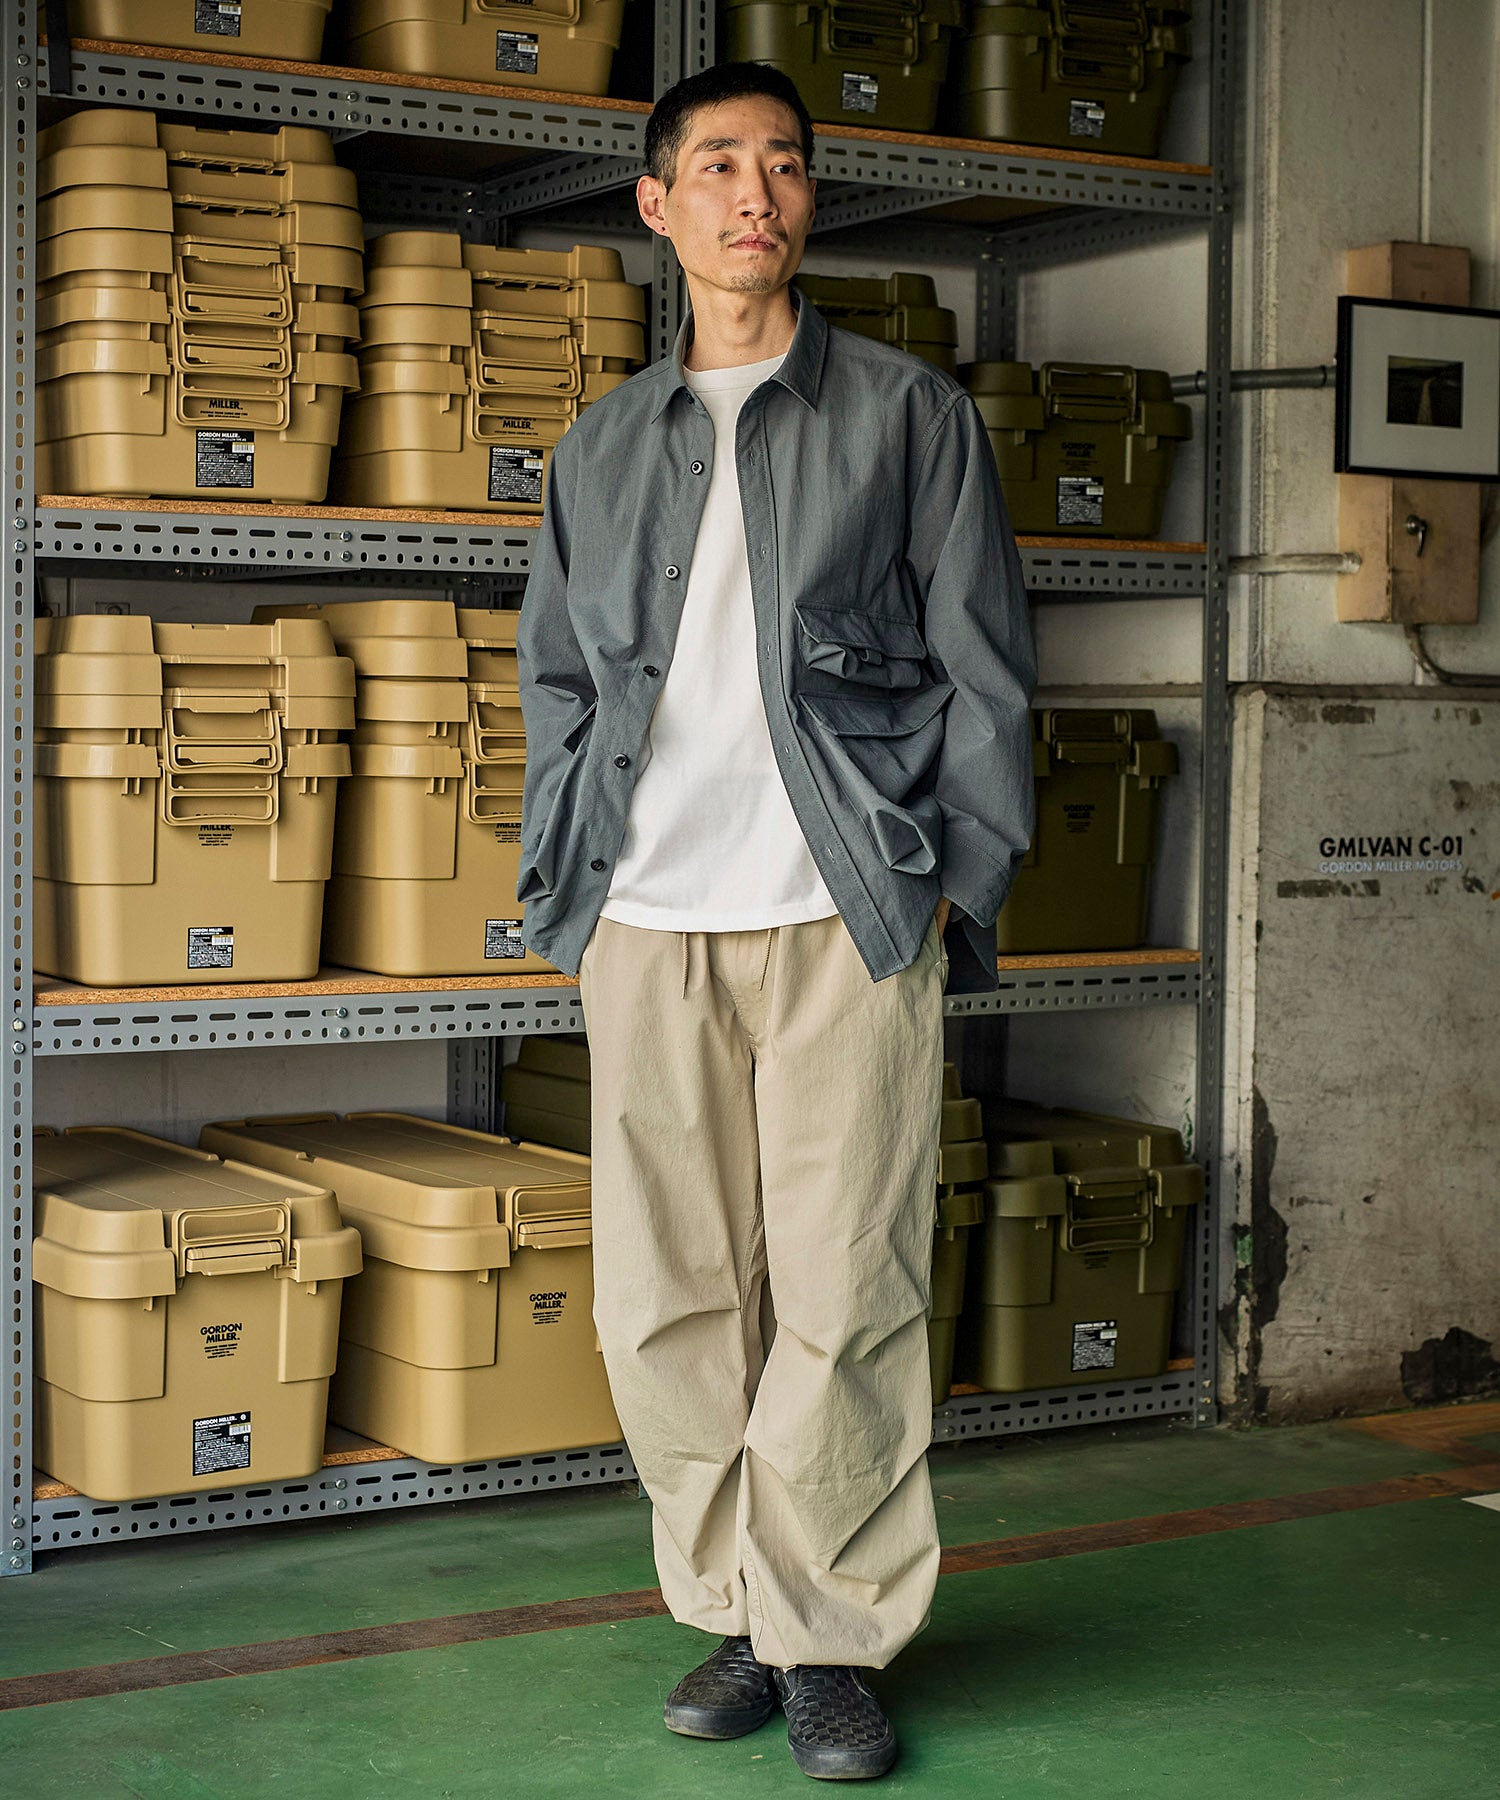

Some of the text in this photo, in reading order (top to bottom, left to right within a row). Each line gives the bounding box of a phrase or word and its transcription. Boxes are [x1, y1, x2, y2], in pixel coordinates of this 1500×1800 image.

[1319, 836, 1463, 858] GMLVAN C-01
[1319, 859, 1463, 874] GORDON MILLER MOTORS
[529, 1291, 567, 1302] GORDON
[200, 1322, 243, 1336] GORDON
